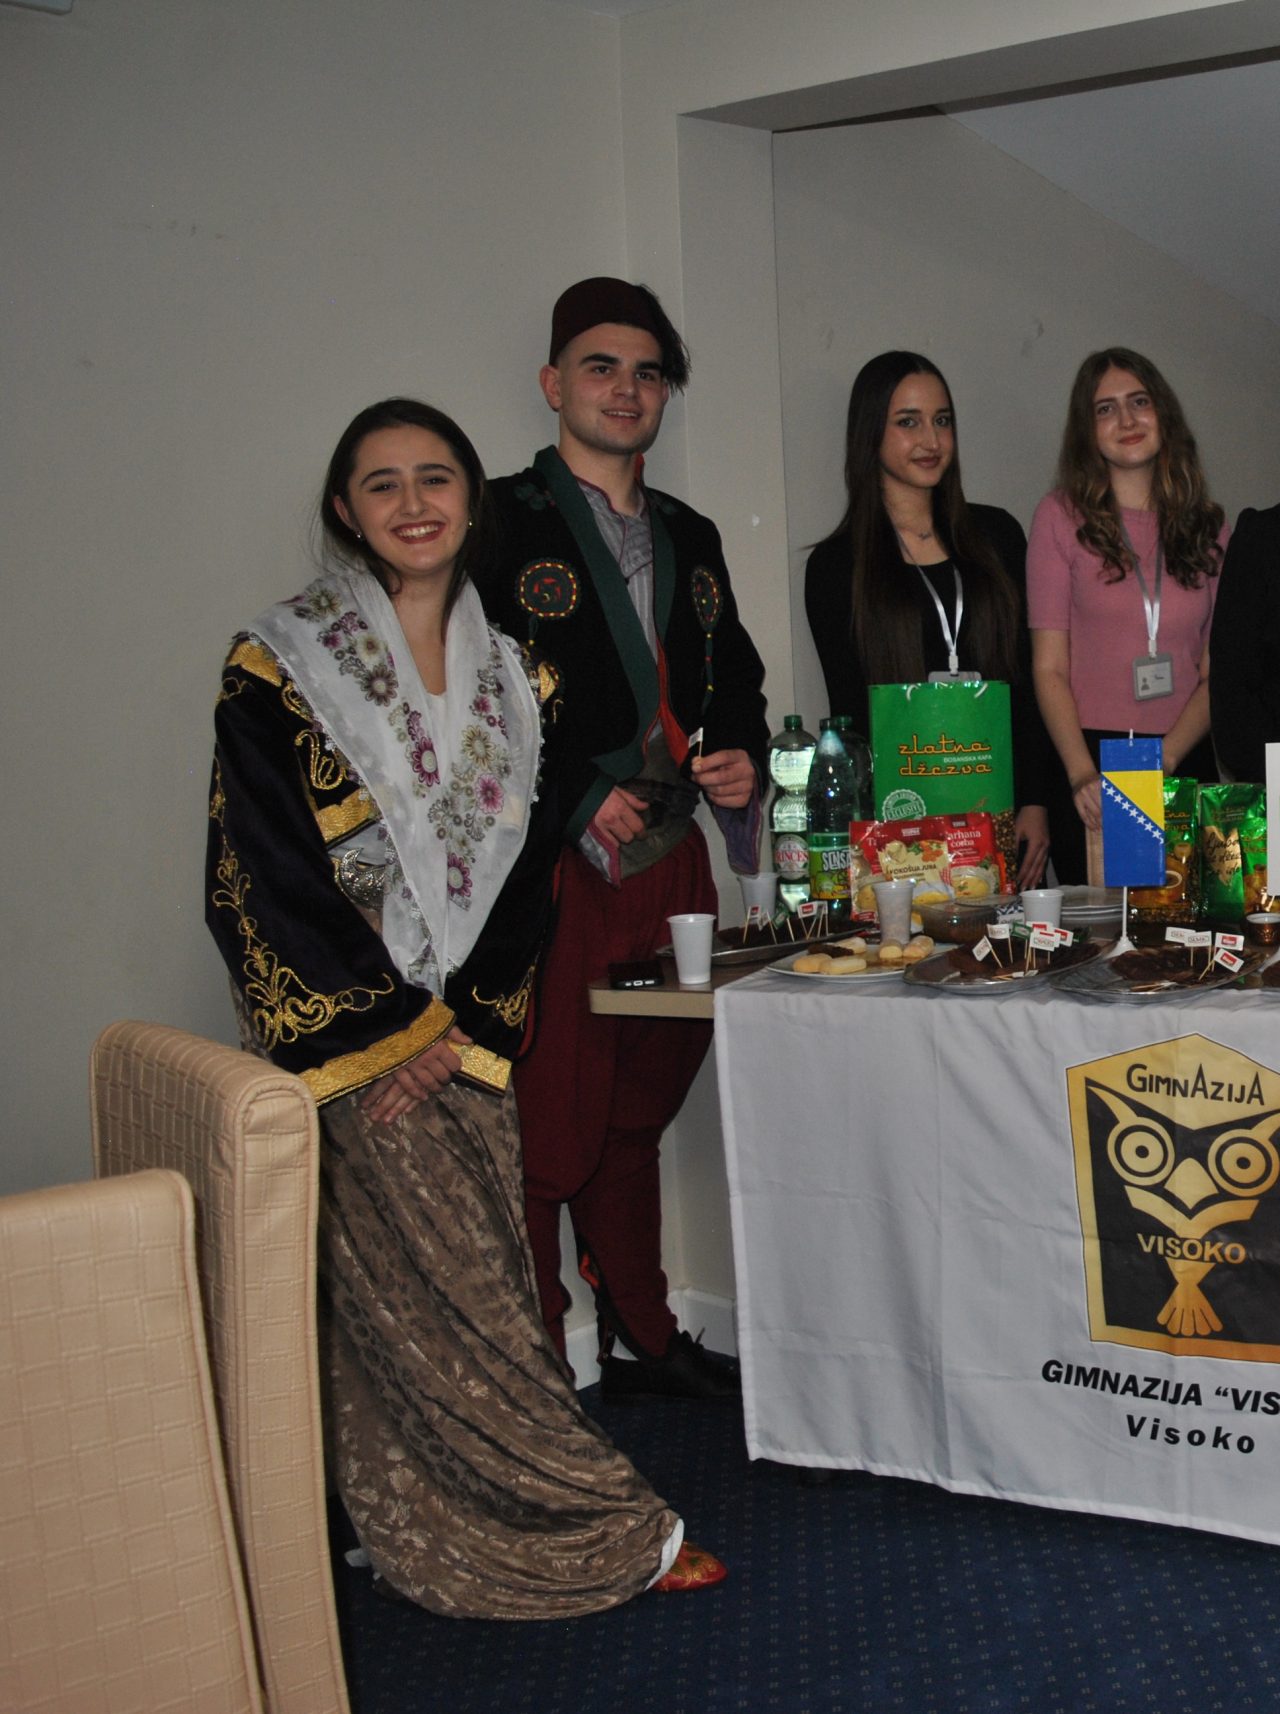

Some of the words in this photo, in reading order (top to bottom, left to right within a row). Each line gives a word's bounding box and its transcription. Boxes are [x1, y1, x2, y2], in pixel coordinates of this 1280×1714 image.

[898, 733, 992, 755] zlatna
[822, 849, 852, 872] SENSA
[1126, 1063, 1265, 1106] GIMNAZIJA
[1136, 1232, 1246, 1265] VISOKO
[1041, 1359, 1203, 1407] GIMNAZIJA
[1126, 1413, 1256, 1455] Visoko
